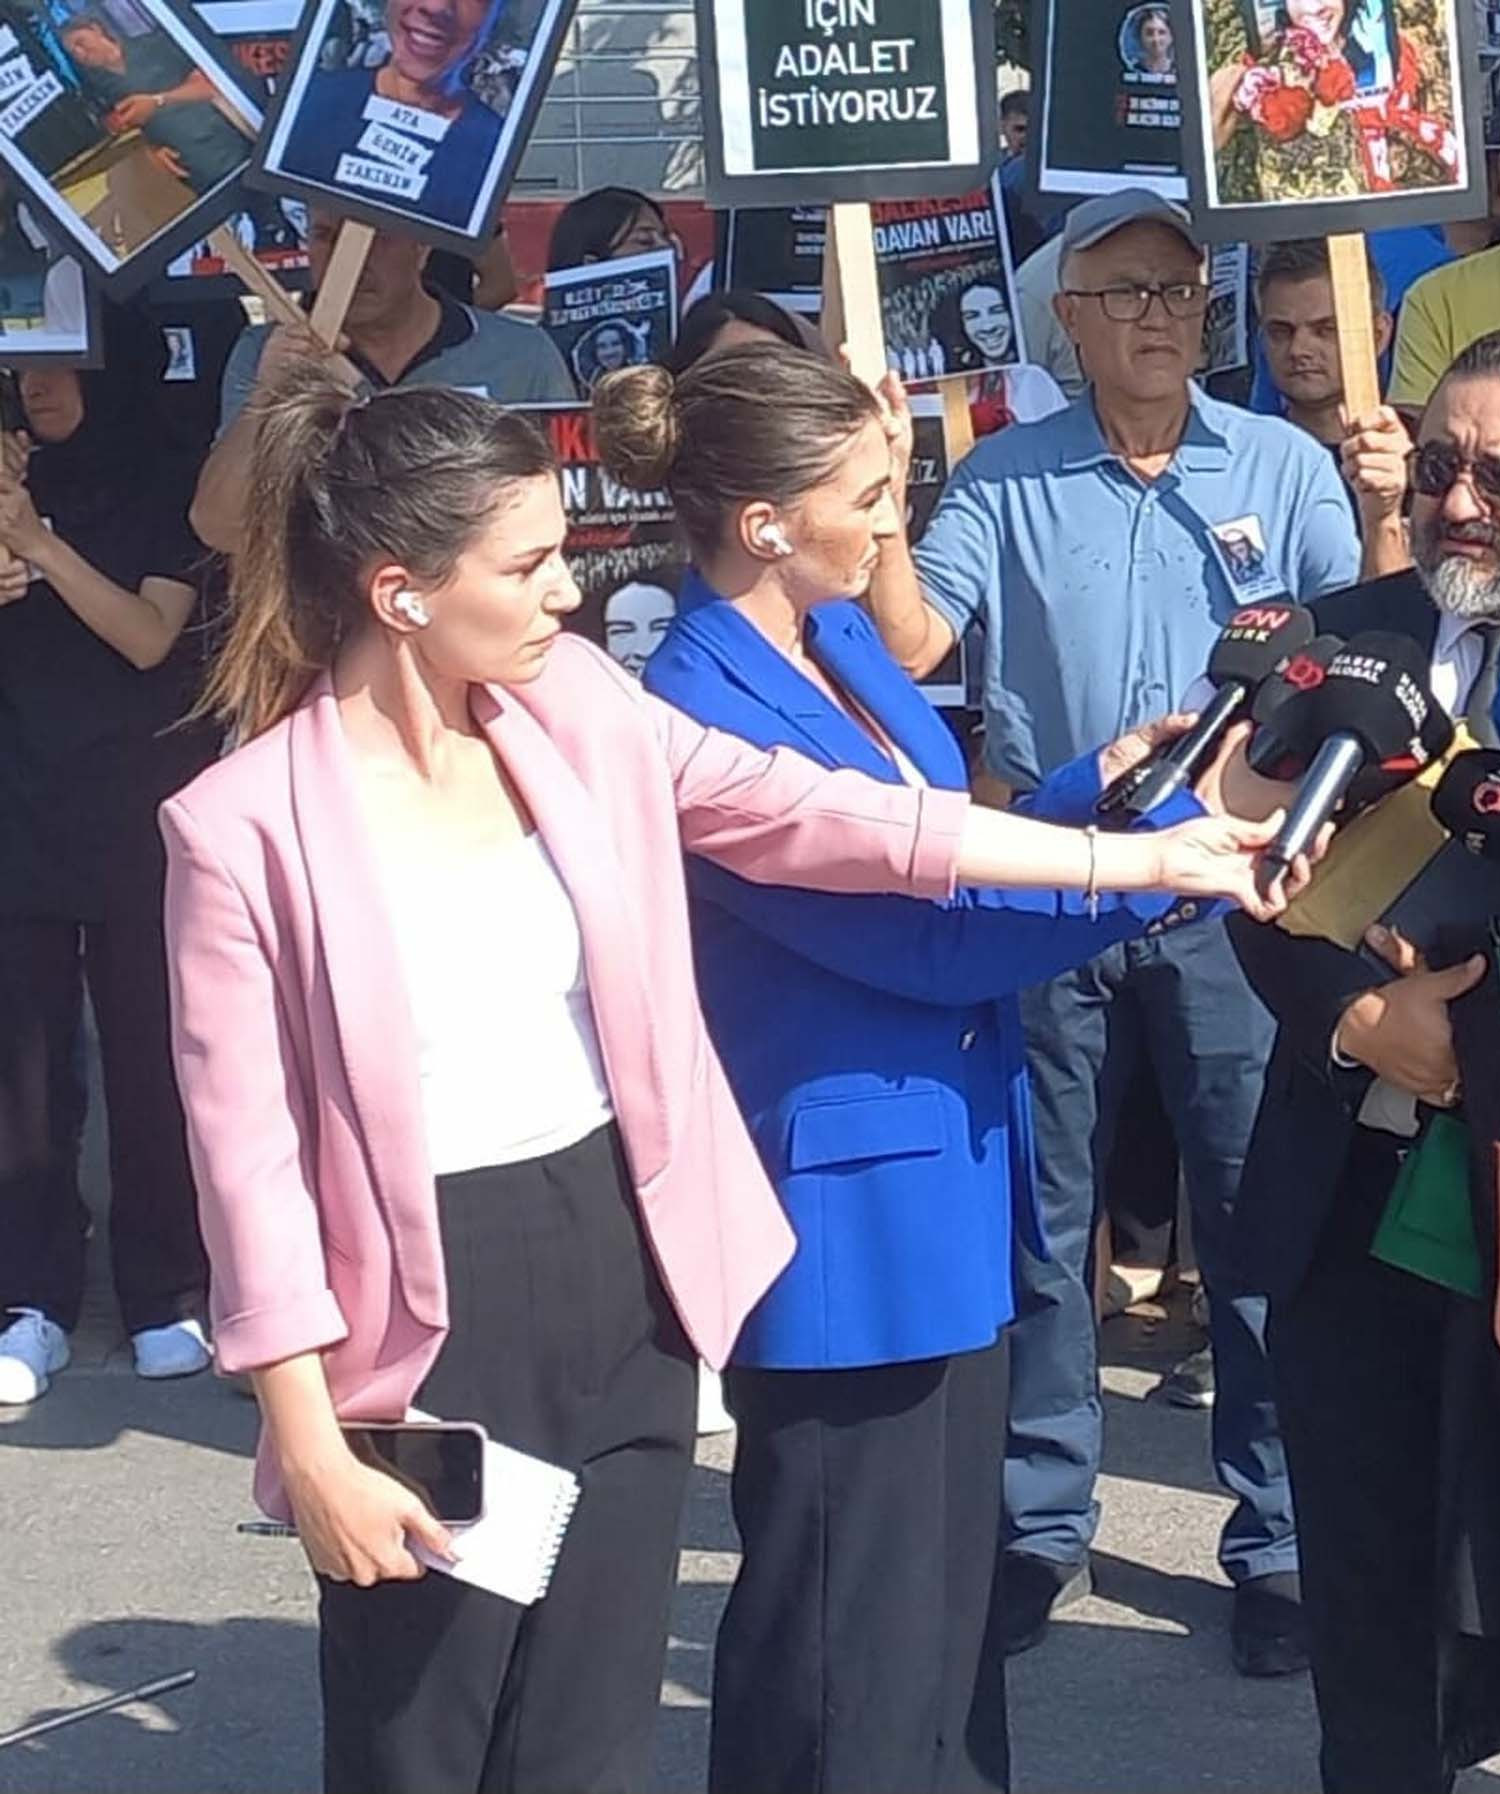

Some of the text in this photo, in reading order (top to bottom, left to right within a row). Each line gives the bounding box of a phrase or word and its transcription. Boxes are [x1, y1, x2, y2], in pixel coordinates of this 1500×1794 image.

[775, 39, 915, 78] ADALET
[758, 85, 938, 127] İSTİYORUZ
[874, 217, 941, 253] DAVAN
[944, 209, 995, 241] VAR!
